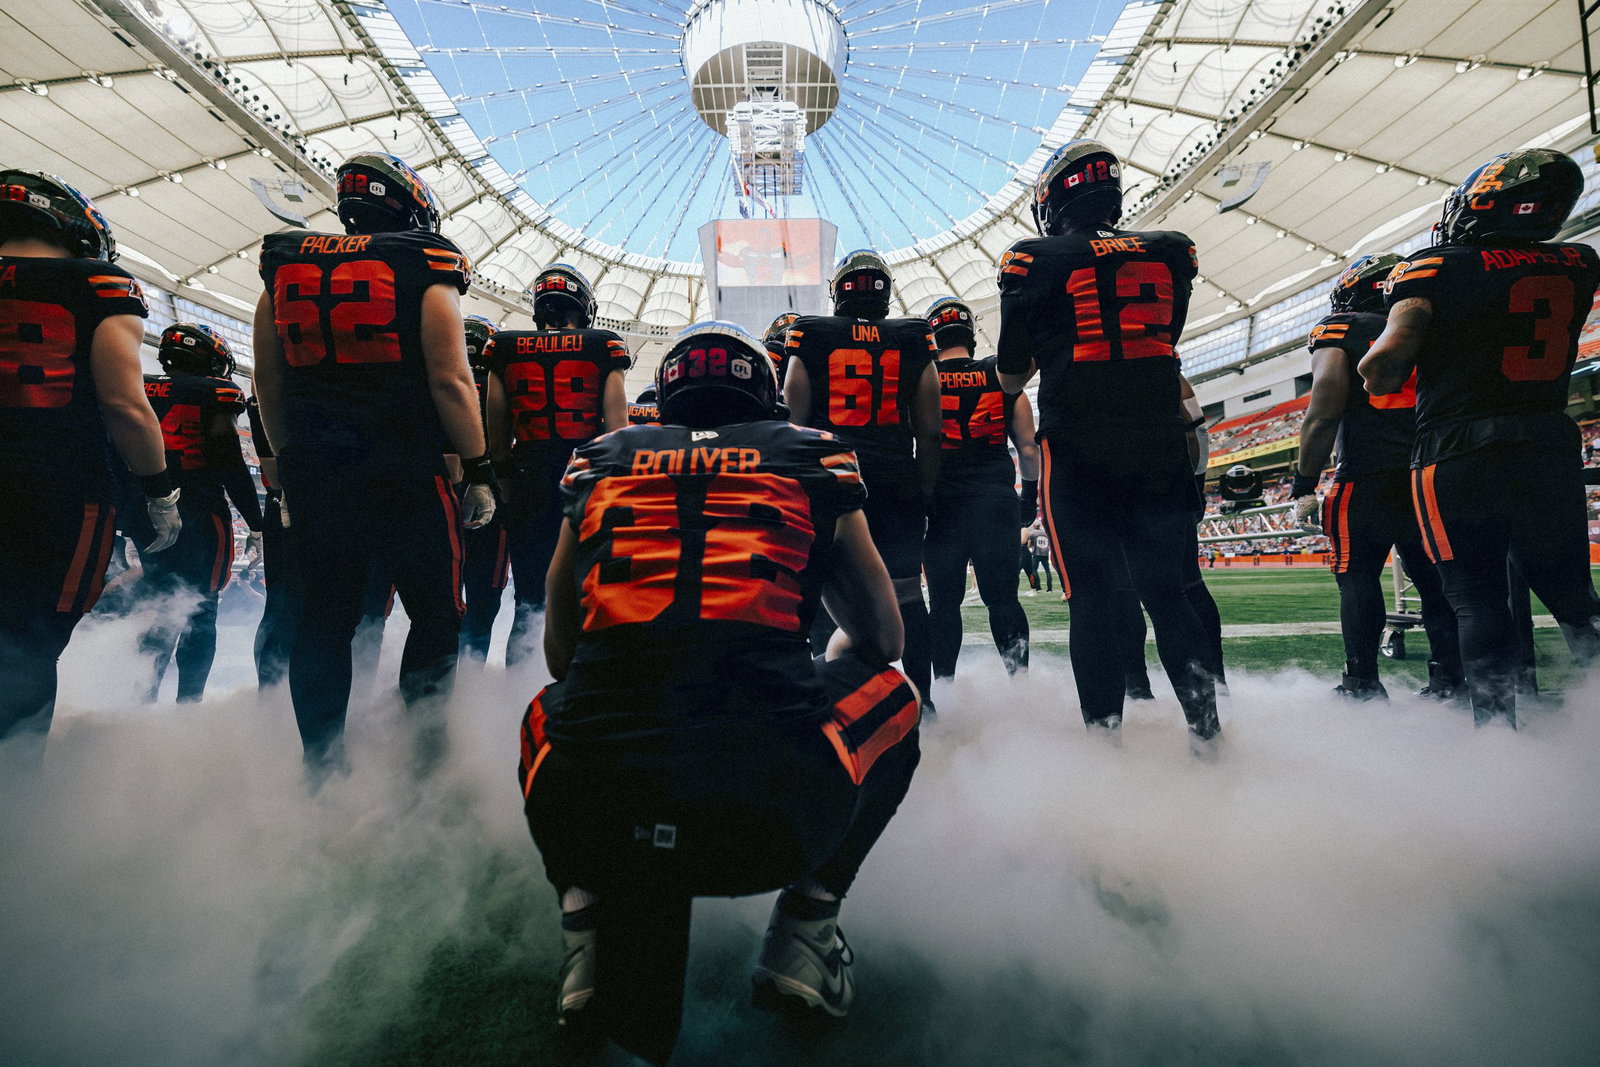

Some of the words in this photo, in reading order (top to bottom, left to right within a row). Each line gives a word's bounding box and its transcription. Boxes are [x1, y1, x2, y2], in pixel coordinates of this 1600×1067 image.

[1086, 161, 1108, 183] 12
[344, 174, 368, 193] 62
[300, 235, 373, 254] PACKER
[1089, 237, 1146, 256] BRICE
[546, 275, 565, 290] 29
[274, 260, 402, 367] 62
[941, 309, 959, 322] 54
[1066, 261, 1174, 361] 12
[852, 325, 880, 342] UNA
[1502, 276, 1574, 381] 3
[517, 334, 583, 354] BEAULIEU
[689, 348, 727, 377] 32
[733, 363, 749, 375] CFL
[829, 349, 900, 426] 61
[939, 371, 987, 388] PEIRSON
[505, 360, 600, 441] 29
